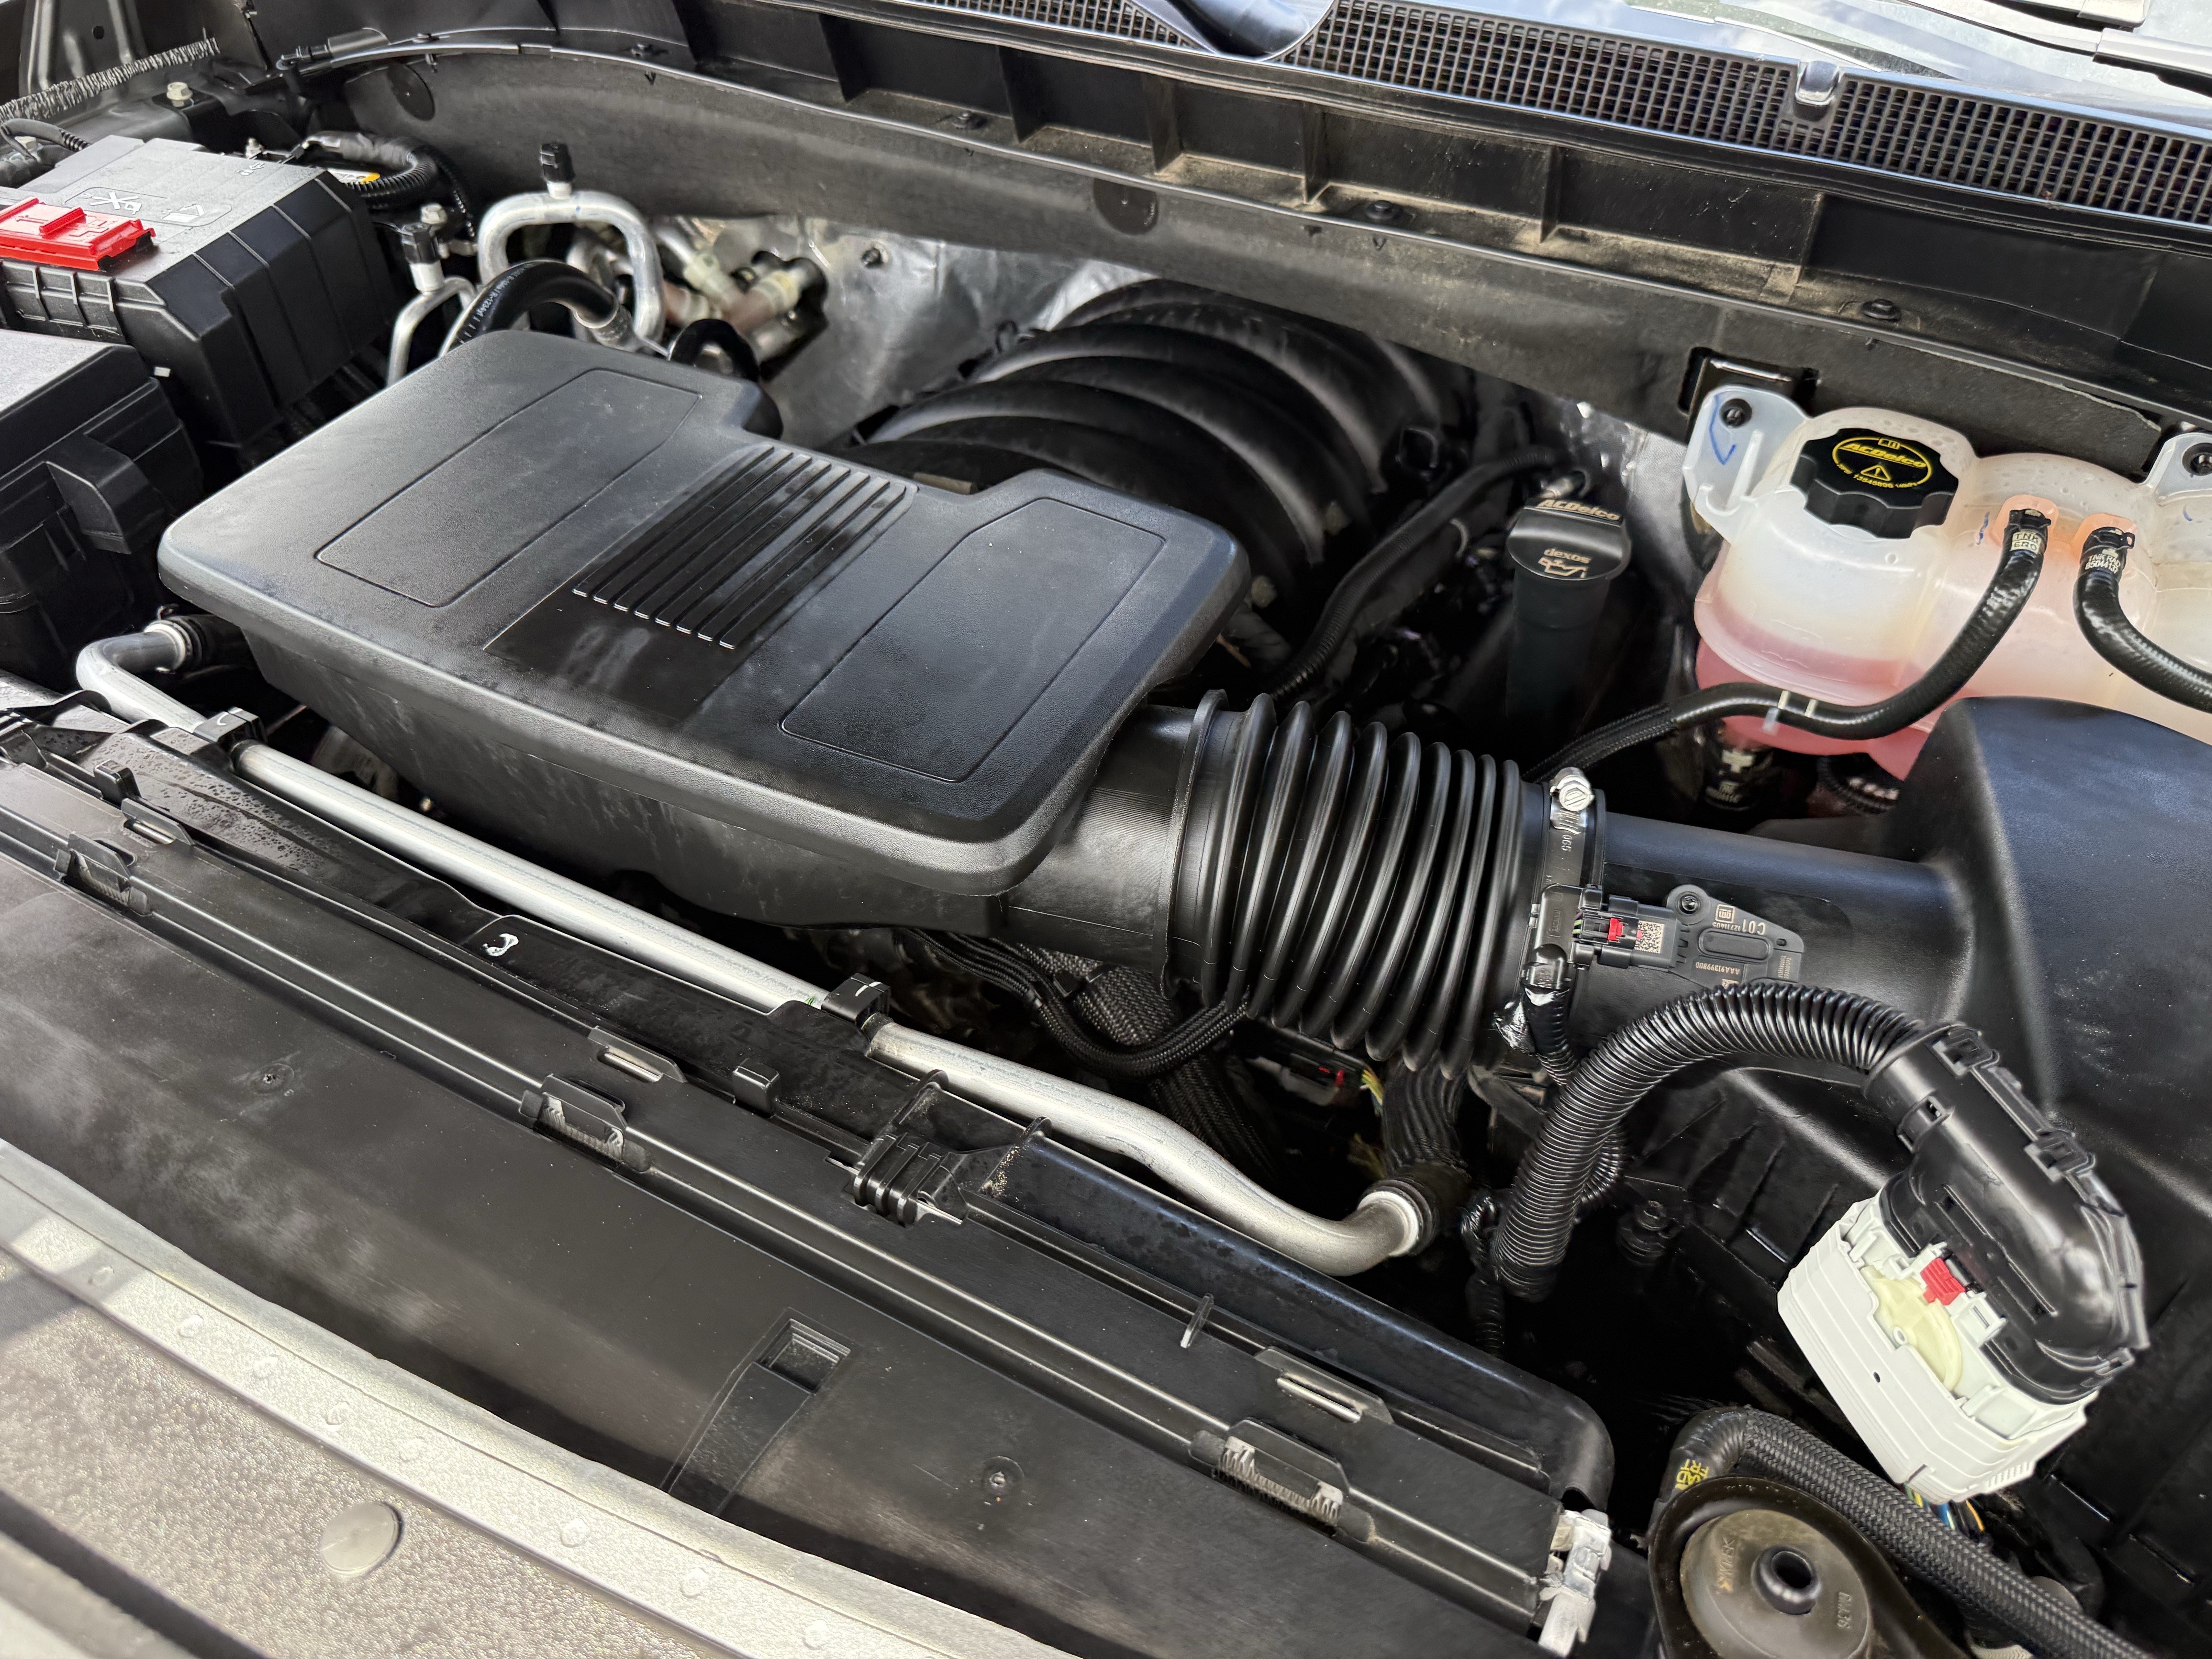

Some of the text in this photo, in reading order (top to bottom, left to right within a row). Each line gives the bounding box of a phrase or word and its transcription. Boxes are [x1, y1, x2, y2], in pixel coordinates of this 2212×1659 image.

[1842, 443, 1927, 468] ACDelco
[1536, 500, 1621, 520] ACDelco
[2015, 533, 2038, 542] TNK
[1544, 548, 1591, 563] dexos
[2106, 555, 2121, 567] RAD
[1712, 921, 1740, 932] 12711405
